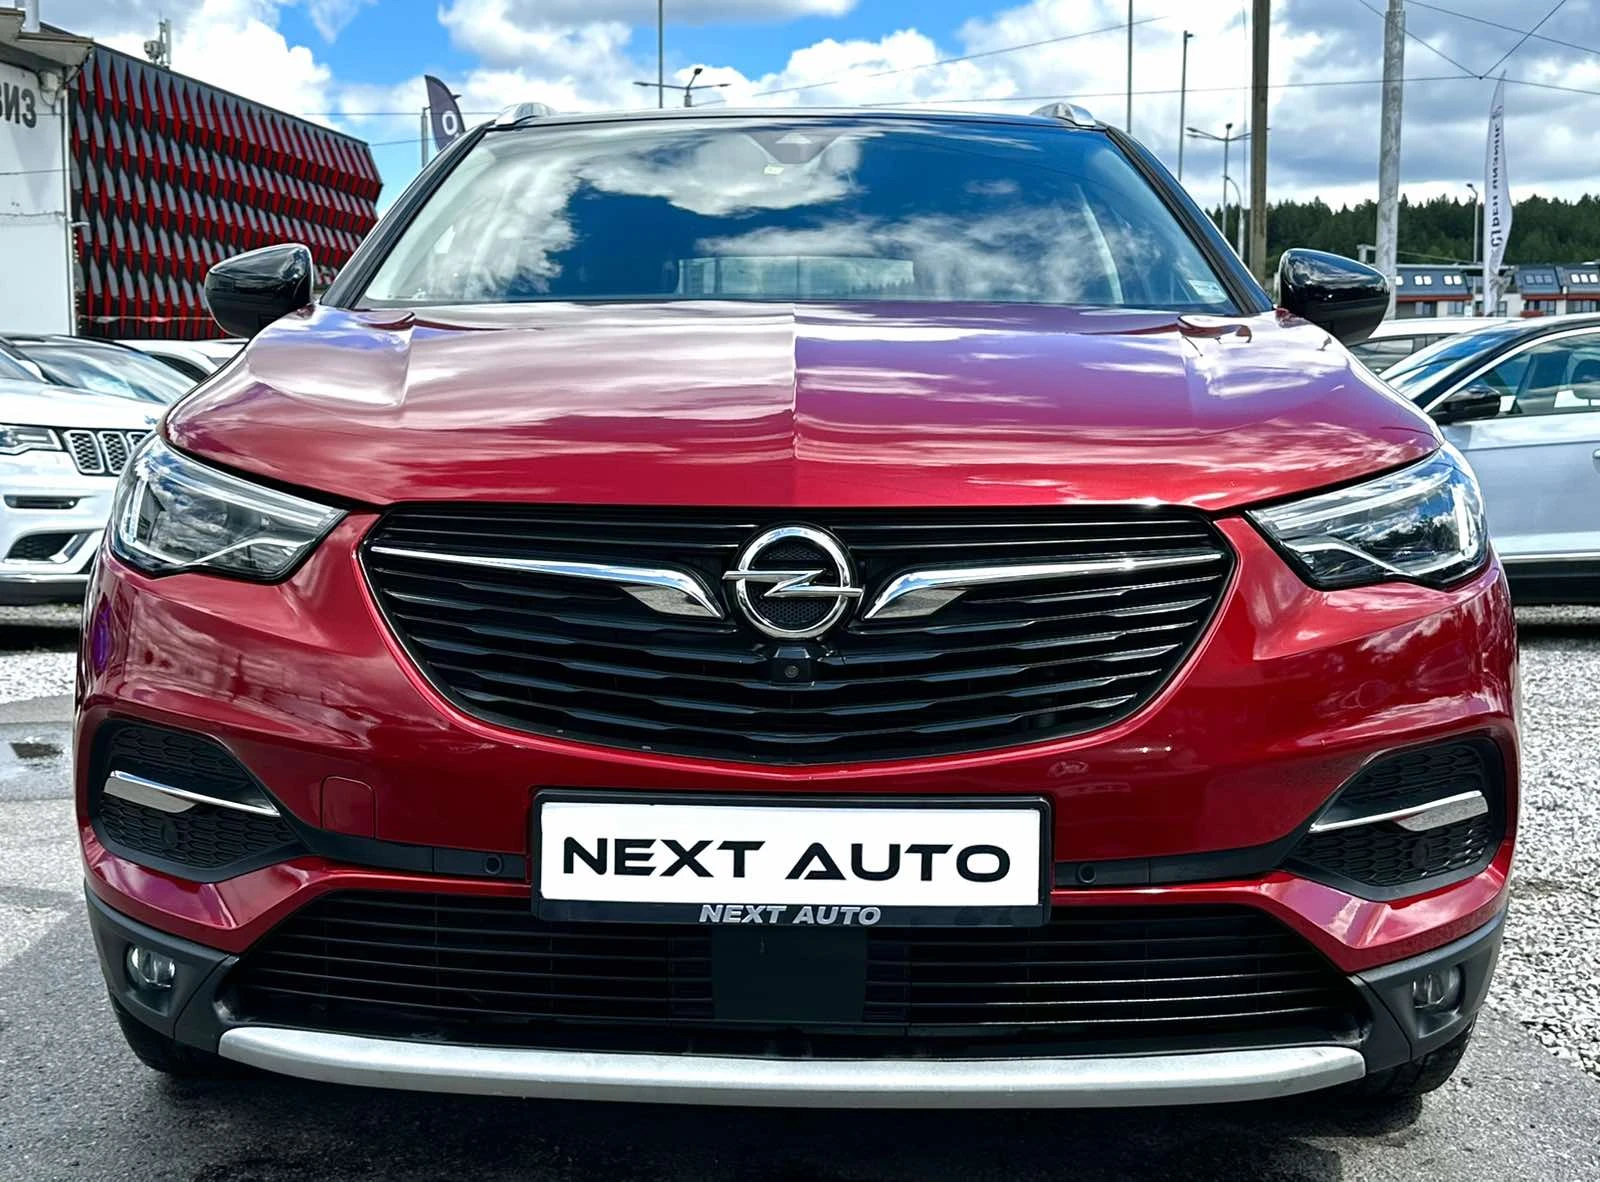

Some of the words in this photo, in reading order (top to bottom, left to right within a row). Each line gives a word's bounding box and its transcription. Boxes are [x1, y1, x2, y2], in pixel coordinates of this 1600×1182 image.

[0, 82, 37, 128] ИЗ
[563, 836, 766, 878] NEXT
[785, 842, 1011, 883] AUTO
[699, 904, 786, 924] NEXT
[792, 905, 881, 926] AUTO
